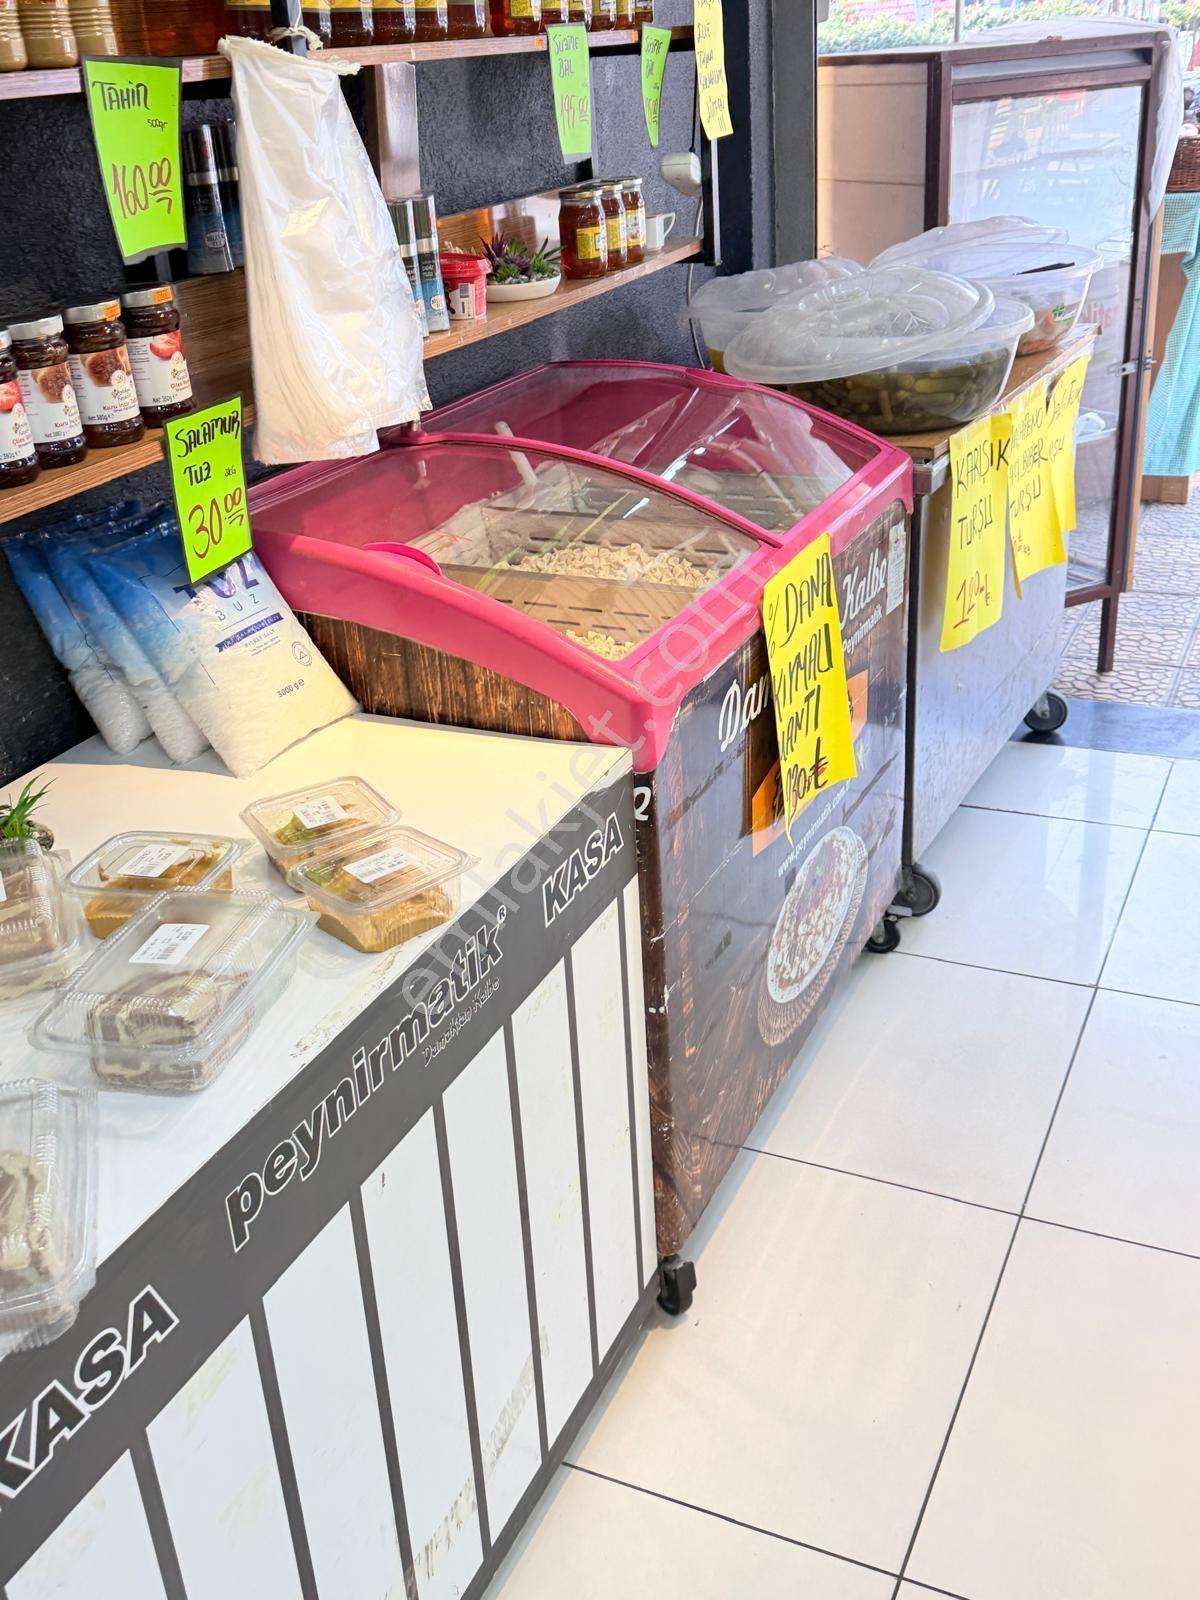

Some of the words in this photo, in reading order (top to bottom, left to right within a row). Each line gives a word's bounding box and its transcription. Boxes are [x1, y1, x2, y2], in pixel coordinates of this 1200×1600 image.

[779, 552, 834, 648] DANA
[276, 684, 294, 698] 3000
[541, 812, 624, 928] KASA
